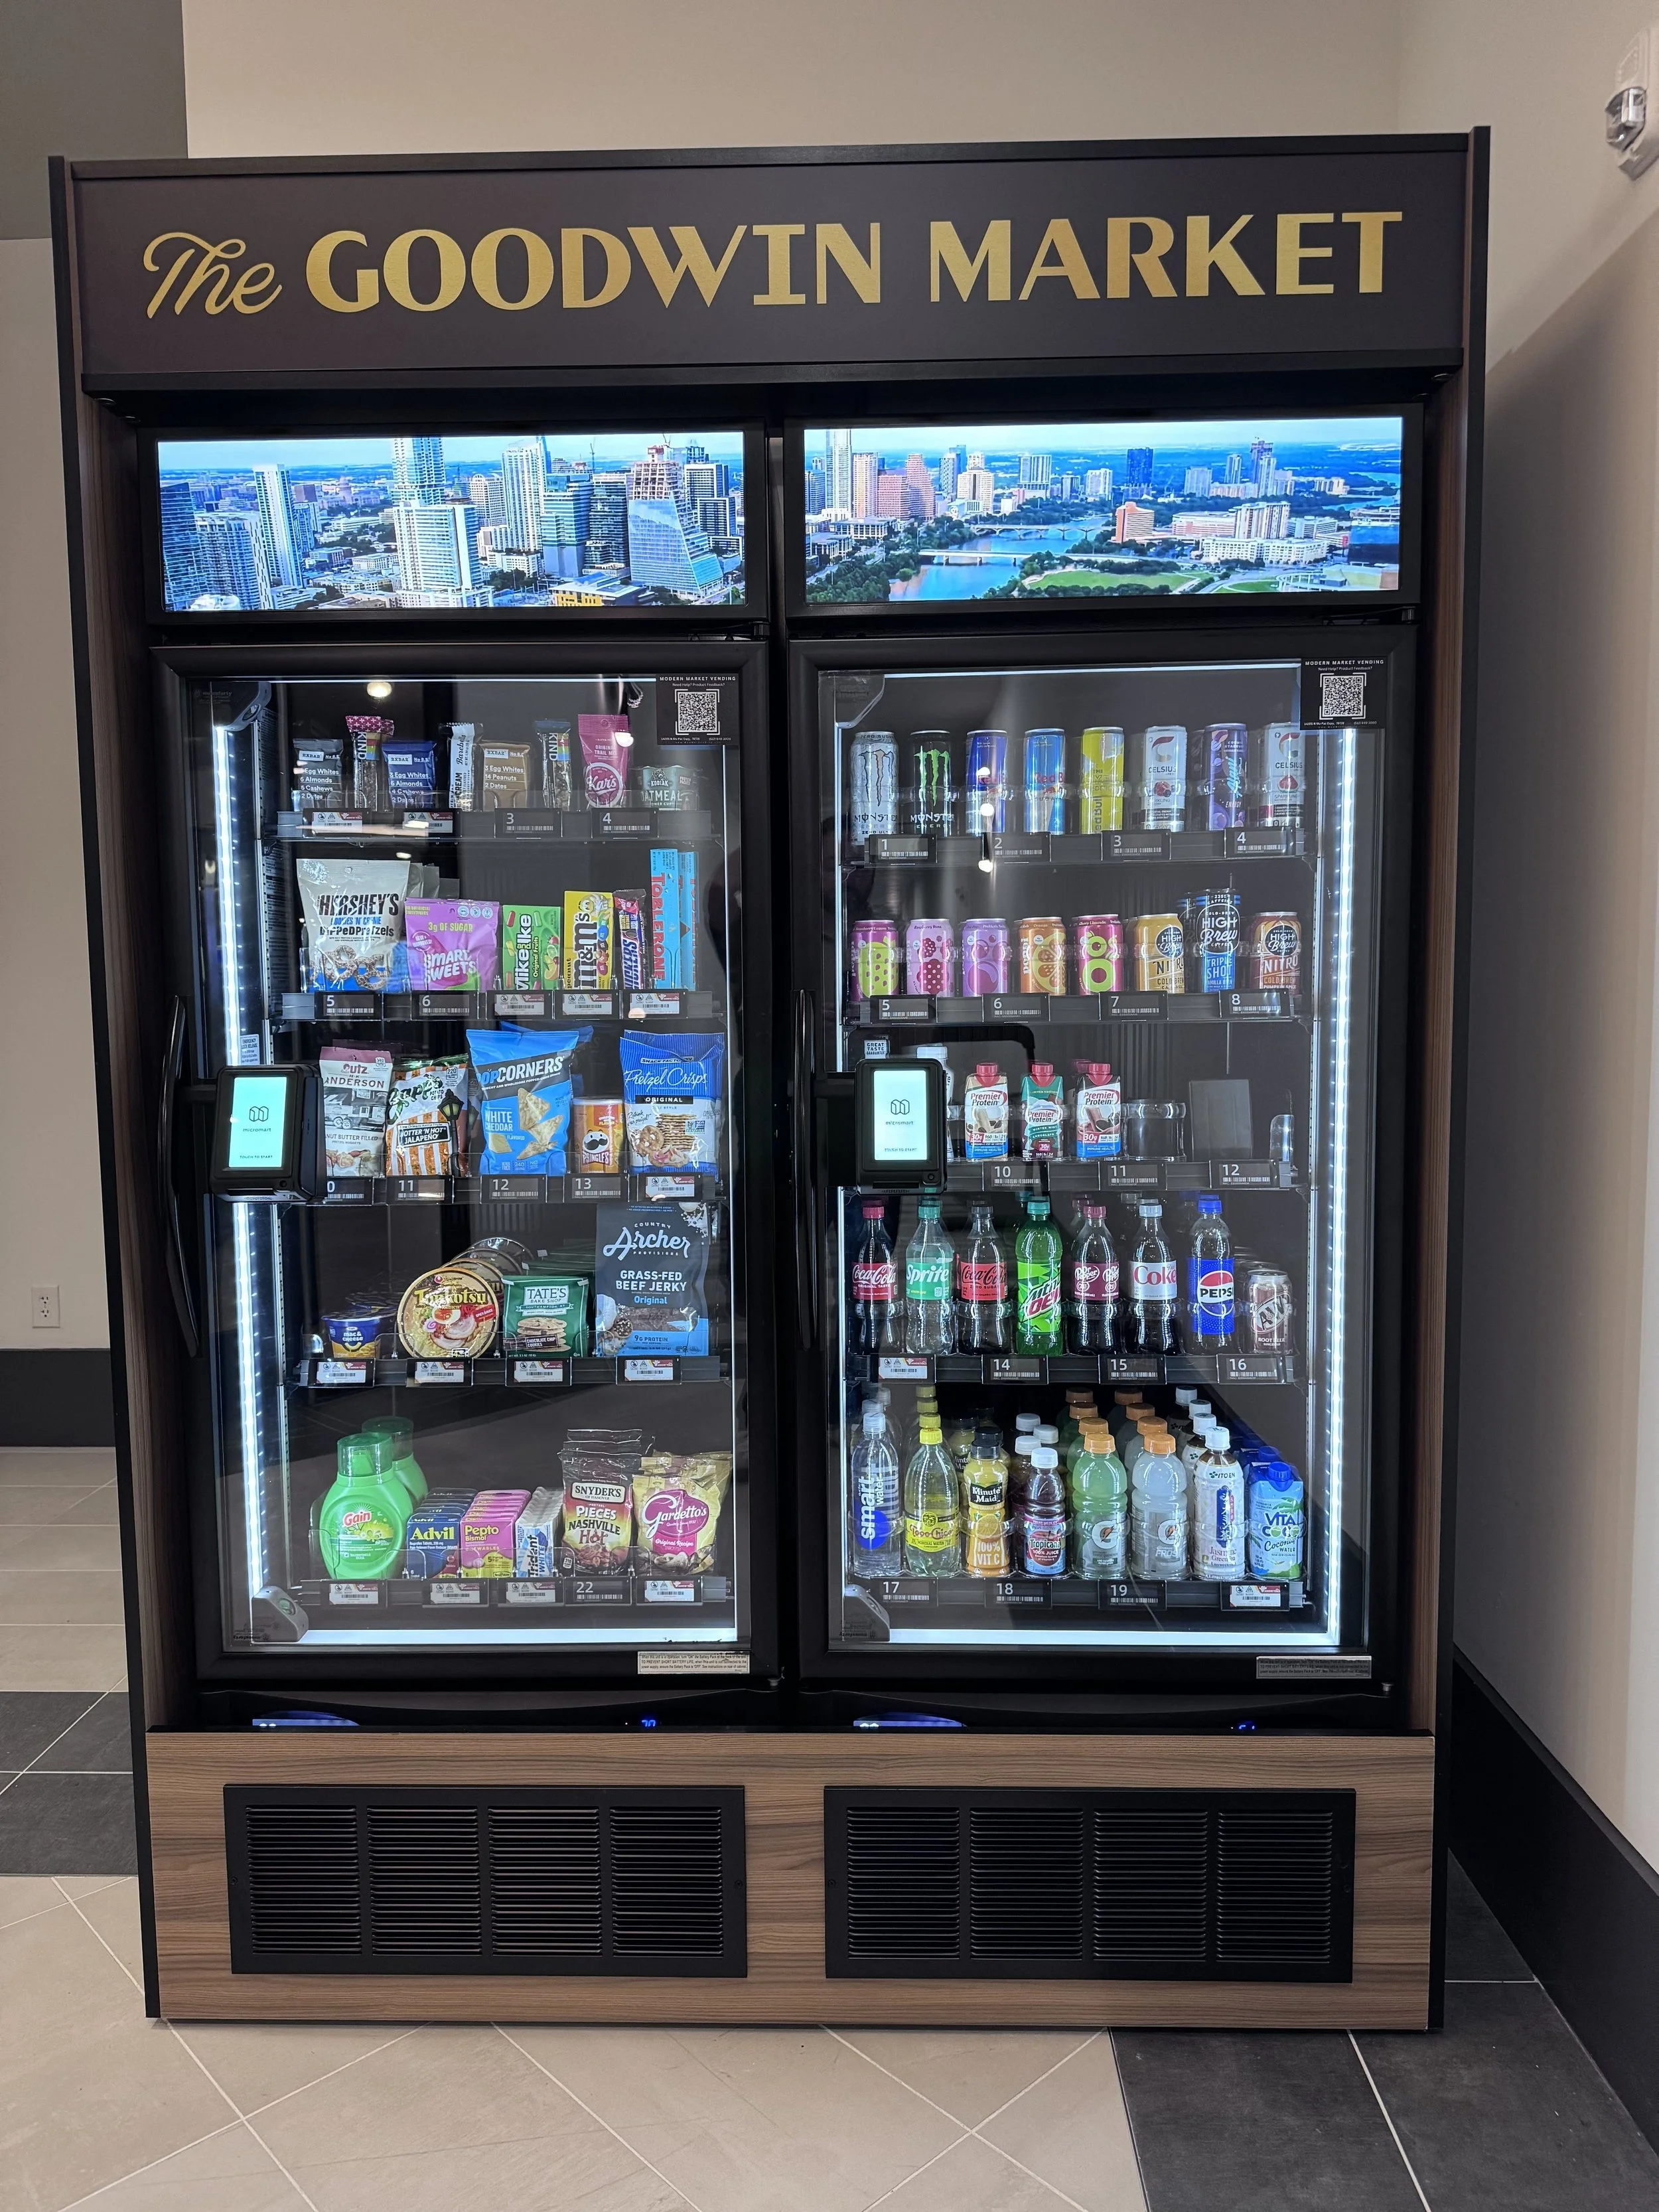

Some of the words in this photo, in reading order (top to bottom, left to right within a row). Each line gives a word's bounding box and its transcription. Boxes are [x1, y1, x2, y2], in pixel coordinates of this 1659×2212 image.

[143, 231, 283, 319] The
[305, 224, 881, 312] GOODWIN
[930, 210, 1403, 303] MARKET
[358, 732, 366, 759] KIND
[587, 776, 616, 790] Kar's
[641, 790, 682, 802] OATMEAL
[507, 813, 514, 824] 3
[603, 813, 611, 824] 4
[995, 838, 1002, 848] 2
[1114, 836, 1121, 846] 3
[1237, 832, 1246, 843] 4
[881, 840, 887, 849] 1
[319, 893, 399, 916] HERSHEY'S
[428, 922, 437, 932] 3g
[451, 923, 472, 932] SUGAR
[1202, 917, 1238, 928] HIGH
[1200, 929, 1238, 945] Brew
[424, 950, 470, 968] SMART
[1264, 955, 1297, 973] NITRO
[425, 961, 476, 983] SWEETS
[1207, 966, 1232, 978] SHOT
[326, 996, 334, 1006] 5
[422, 996, 431, 1006] 6
[994, 998, 1002, 1008] 6
[1111, 996, 1119, 1007] 7
[1232, 994, 1240, 1004] 8
[882, 1000, 889, 1010] 5
[624, 1067, 668, 1092] Pretzel
[668, 1068, 707, 1090] Crisps
[485, 1112, 512, 1122] WHITE
[405, 1134, 439, 1144] JALAPEÑO
[994, 1167, 1010, 1177] 10
[1111, 1165, 1125, 1176] 11
[1222, 1165, 1239, 1175] 12
[399, 1181, 413, 1191] 11
[492, 1179, 509, 1190] 12
[575, 1179, 591, 1189] 13
[603, 1227, 691, 1261] Archer
[620, 1270, 682, 1281] GRASS-FED
[906, 1264, 949, 1285] Sprite
[1077, 1269, 1098, 1280] Pepper
[1134, 1266, 1175, 1285] Coke
[616, 1280, 646, 1290] BEEF
[649, 1282, 686, 1291] JERKY
[528, 1288, 566, 1299] TATE'S
[634, 1296, 667, 1305] Original
[993, 1359, 1010, 1370] 14
[1111, 1359, 1127, 1370] 15
[1230, 1359, 1246, 1370] 16
[575, 1486, 620, 1497] SNYDER'S
[972, 1487, 1000, 1495] Minute
[576, 1506, 616, 1520] PIECES
[859, 1476, 875, 1539] smart
[344, 1511, 371, 1526] Gain
[642, 1495, 707, 1539] Gardetto's
[1265, 1512, 1295, 1526] VITA
[465, 1525, 498, 1536] Pepto
[568, 1520, 620, 1535] NASHVILLE
[1262, 1526, 1299, 1537] COCO
[410, 1527, 454, 1540] Advil
[977, 1541, 1000, 1552] 100%
[528, 1534, 538, 1577] Trident
[977, 1554, 991, 1565] VIT
[994, 1554, 999, 1565] C
[577, 1582, 593, 1592] 22
[883, 1582, 899, 1593] 17
[996, 1584, 1013, 1594] 18
[1111, 1585, 1127, 1596] 19
